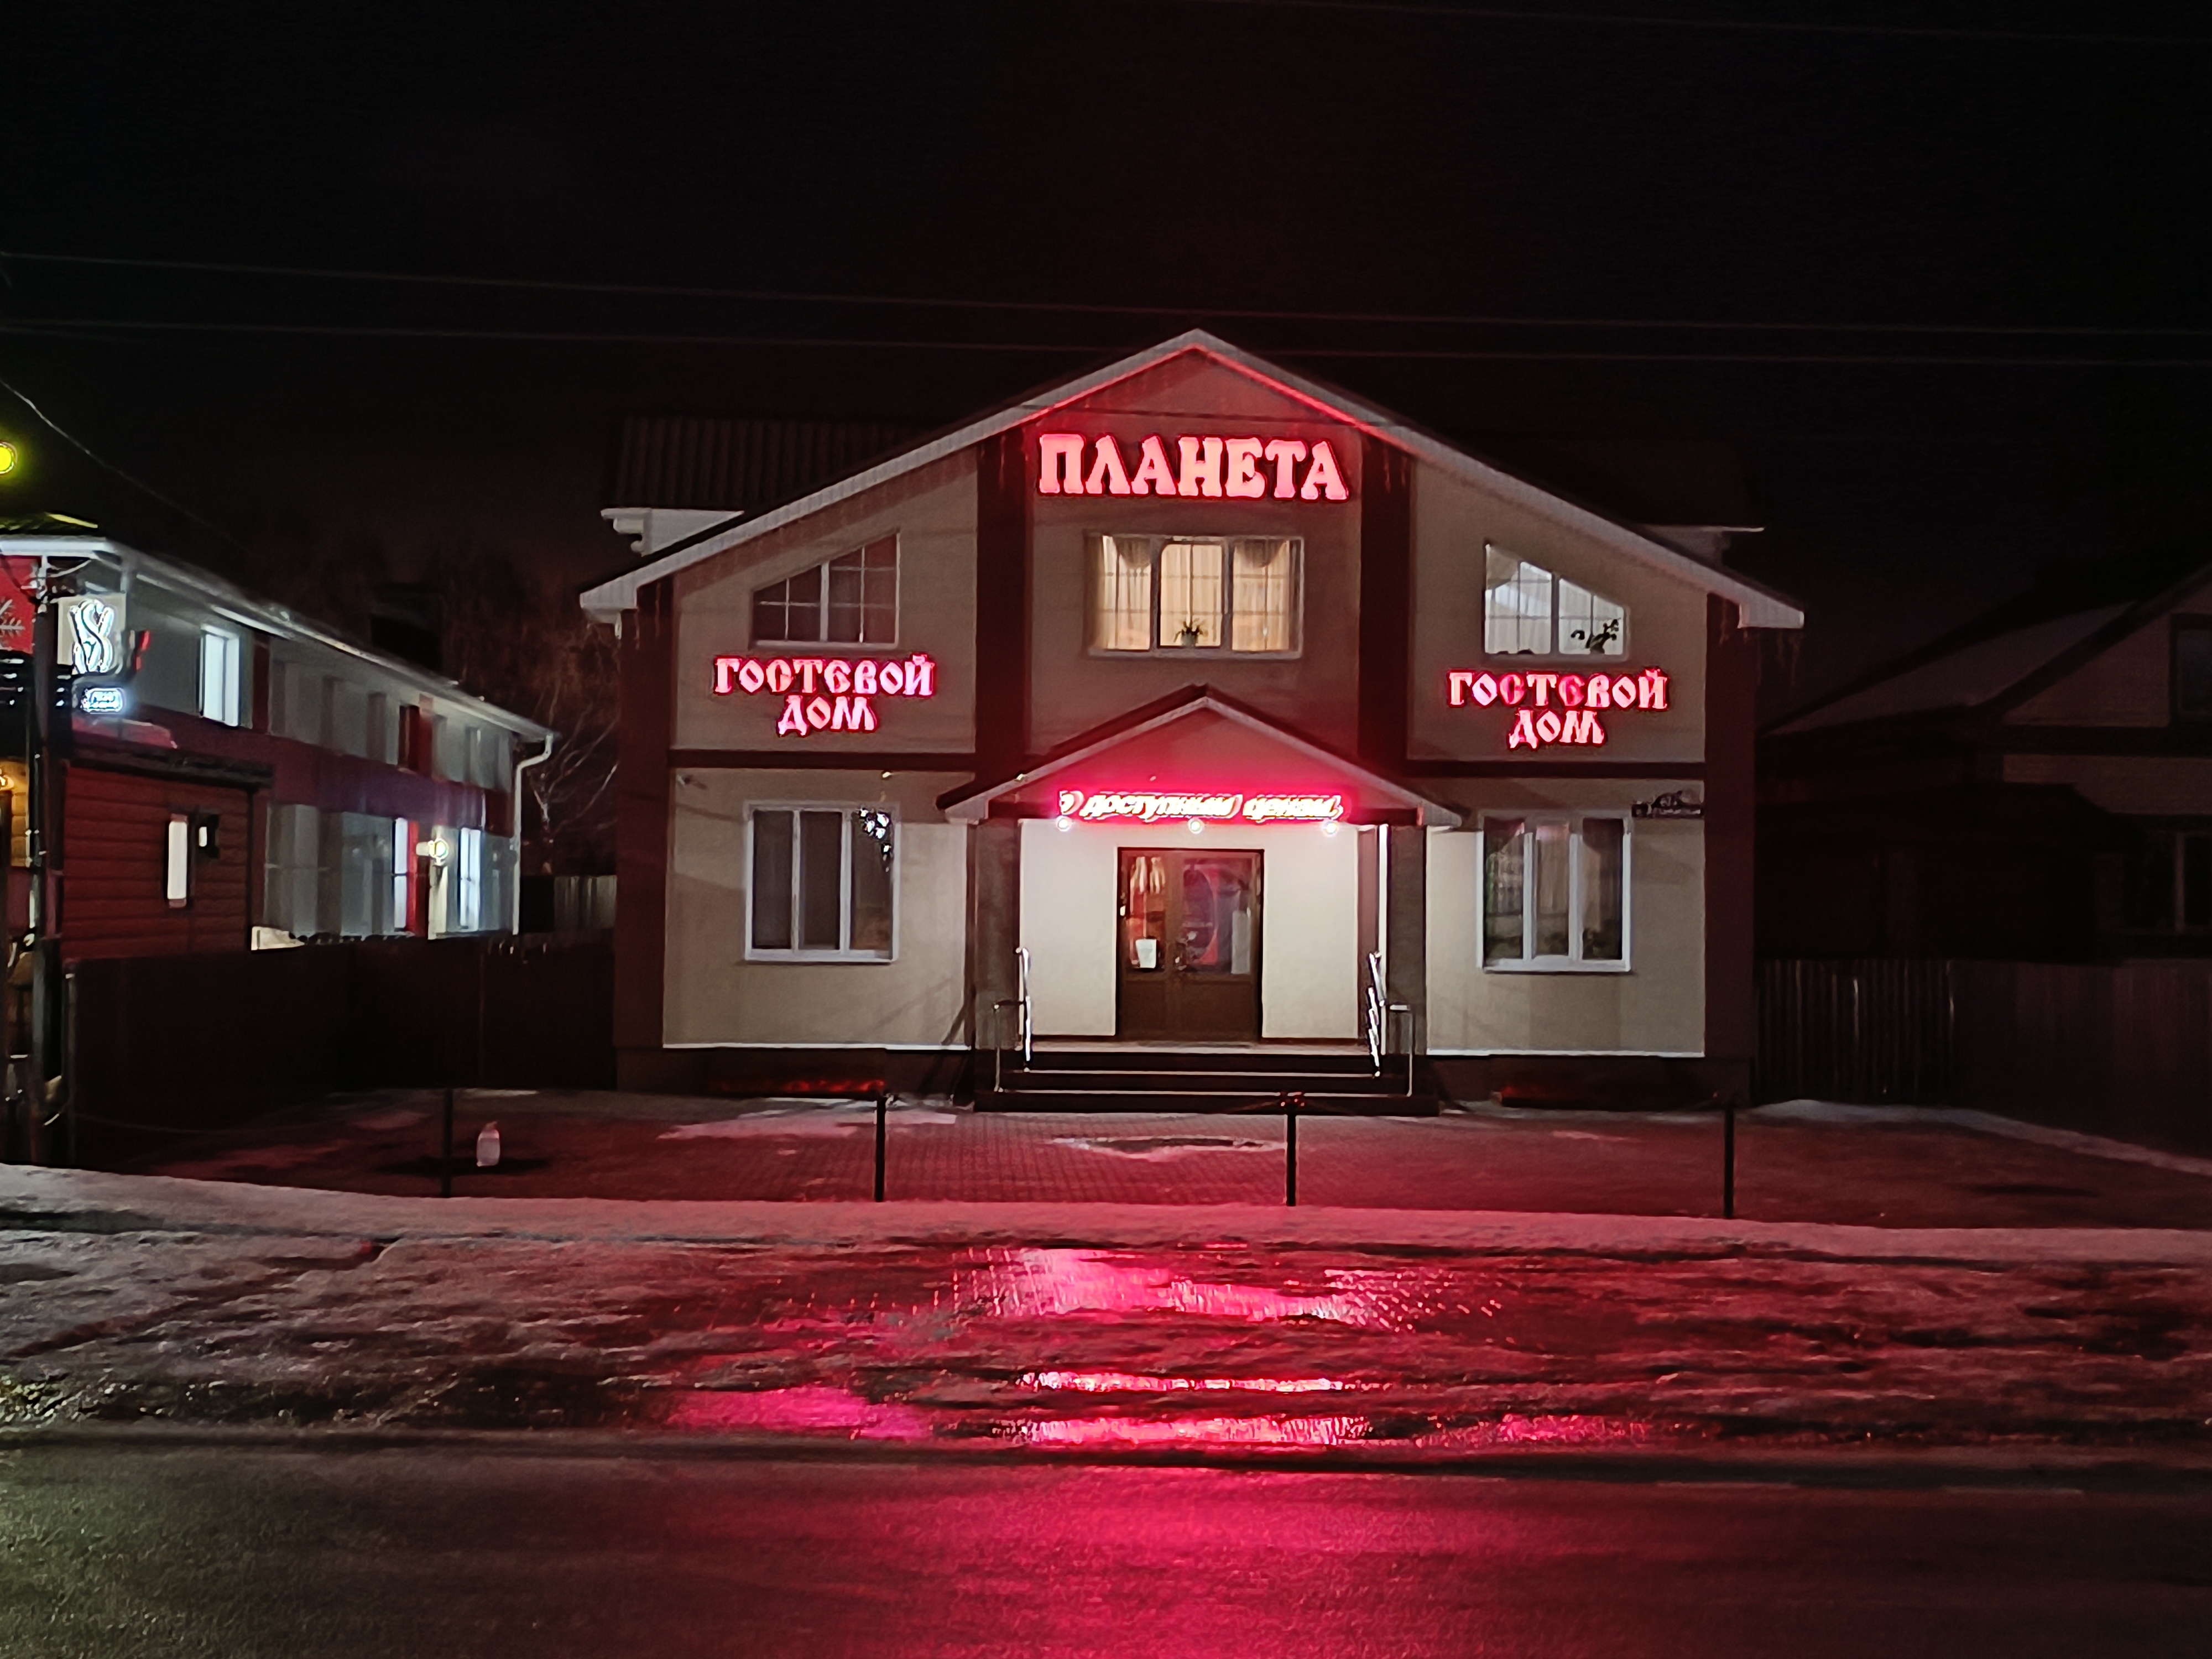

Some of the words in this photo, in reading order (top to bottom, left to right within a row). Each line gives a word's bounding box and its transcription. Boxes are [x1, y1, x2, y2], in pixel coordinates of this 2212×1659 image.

[1039, 433, 1349, 500] ПЛАНЕТА
[713, 653, 937, 697] ГОСТЕВОЙ
[1447, 668, 1669, 710] ГОСТЕВОЙ
[776, 695, 878, 737] ДОМ
[1508, 708, 1605, 749] ДОМ
